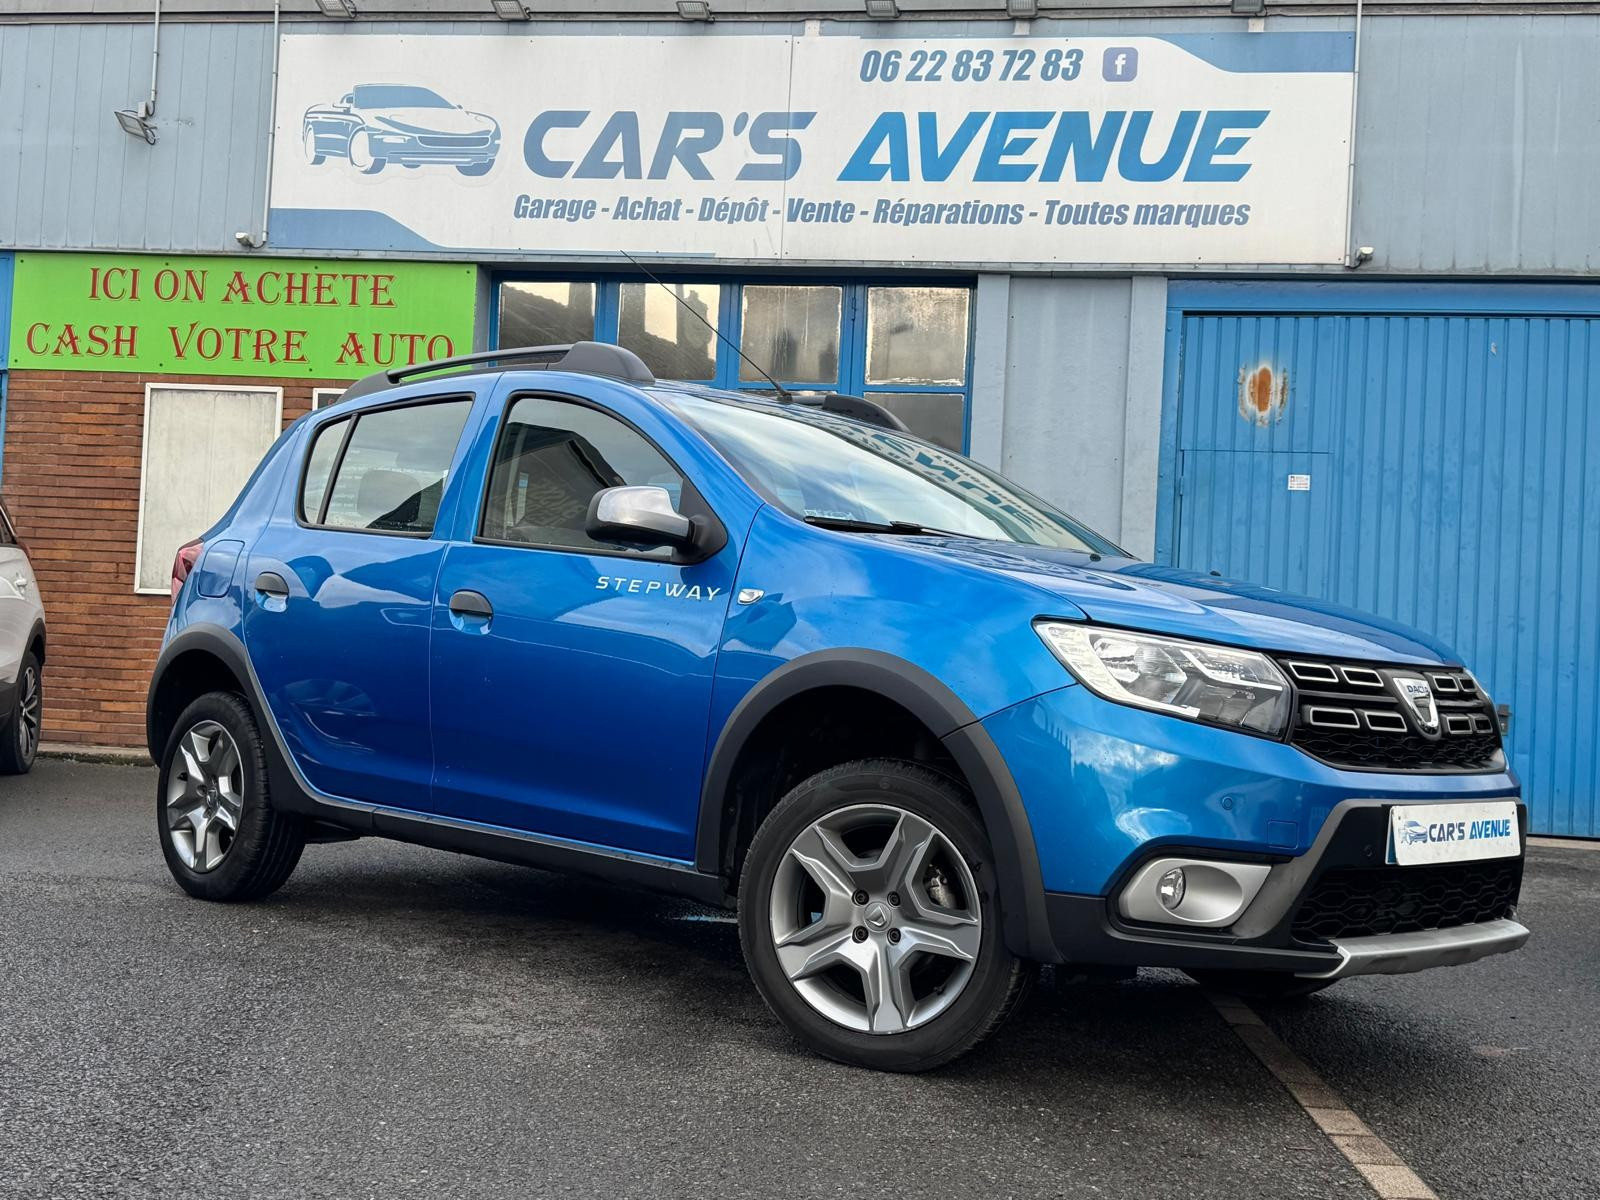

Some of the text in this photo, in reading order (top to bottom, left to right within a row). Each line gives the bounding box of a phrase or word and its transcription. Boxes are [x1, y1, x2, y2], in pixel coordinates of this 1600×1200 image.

[859, 49, 1084, 82] 06 22 83 72 83
[523, 110, 1271, 183] CAR'S AVENUE
[513, 194, 597, 222] Garage
[612, 196, 683, 222] Achat
[699, 197, 769, 225] Dépôt
[786, 198, 856, 223] Vente
[873, 198, 1024, 228] Réparations
[1044, 200, 1128, 225] Toutes
[1132, 203, 1251, 229] marques
[89, 267, 397, 308] ICI ON ACHETE
[26, 320, 456, 367] CASH VOTRE AUTO
[595, 576, 721, 601] STEPWAY
[1428, 818, 1511, 843] CAR'S AVENUE
